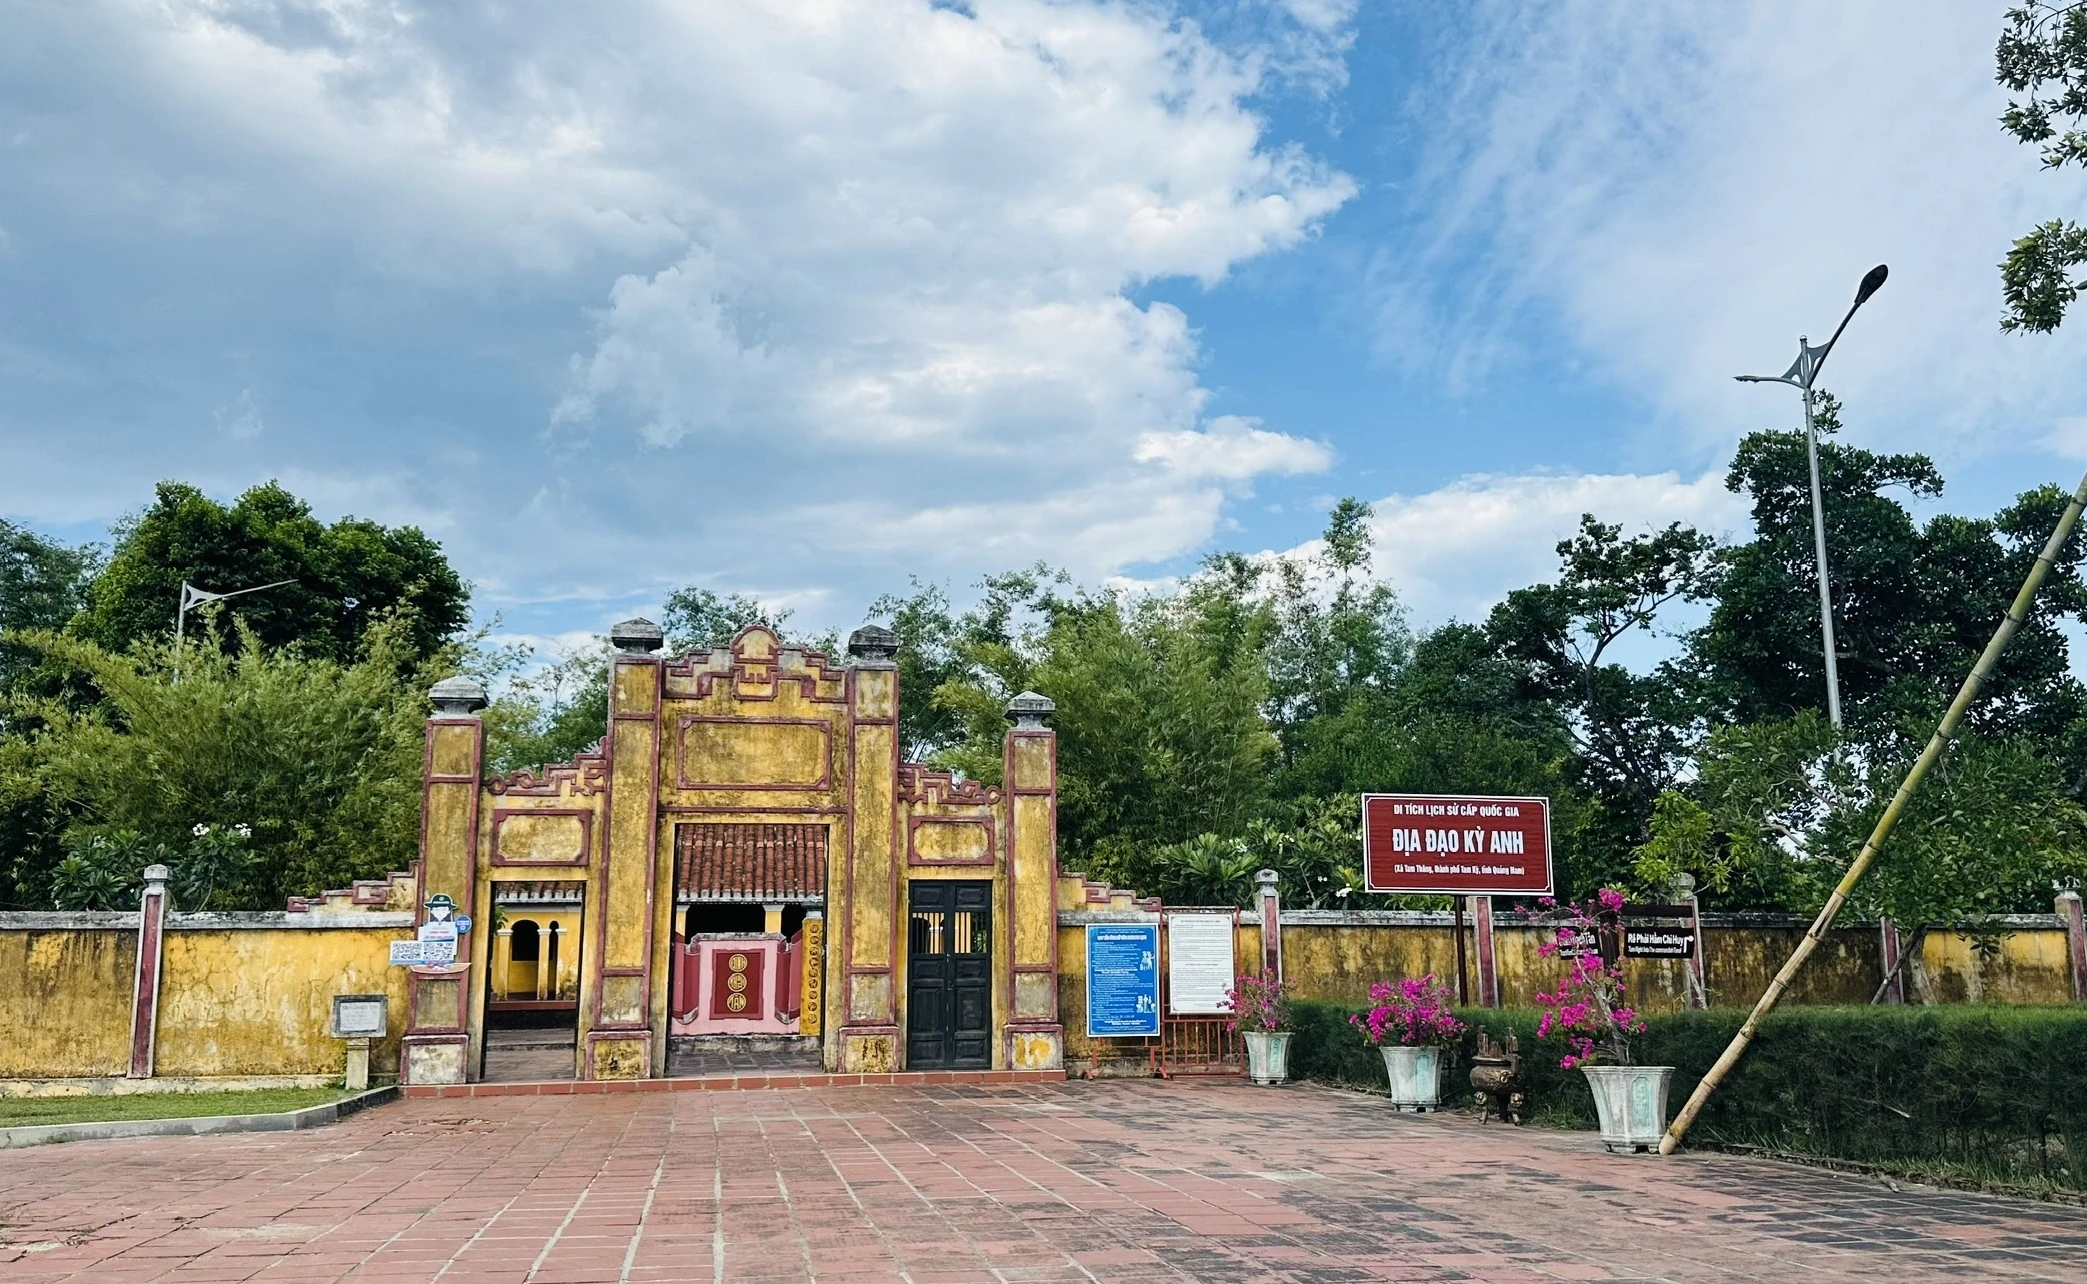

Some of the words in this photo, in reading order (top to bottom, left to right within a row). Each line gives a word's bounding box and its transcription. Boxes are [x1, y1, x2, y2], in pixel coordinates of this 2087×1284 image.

[1393, 804, 1403, 815] DI
[1404, 802, 1424, 816] TÍCH
[1425, 804, 1445, 817] LỊCH
[1446, 802, 1460, 816] SỬ
[1460, 803, 1478, 816] CẤP
[1479, 803, 1503, 817] QUỐC
[1504, 806, 1520, 817] GIA
[1392, 828, 1421, 857] ĐỊA
[1425, 829, 1460, 857] ĐẠO
[1463, 825, 1485, 853] KỲ
[1489, 830, 1524, 855] ANH
